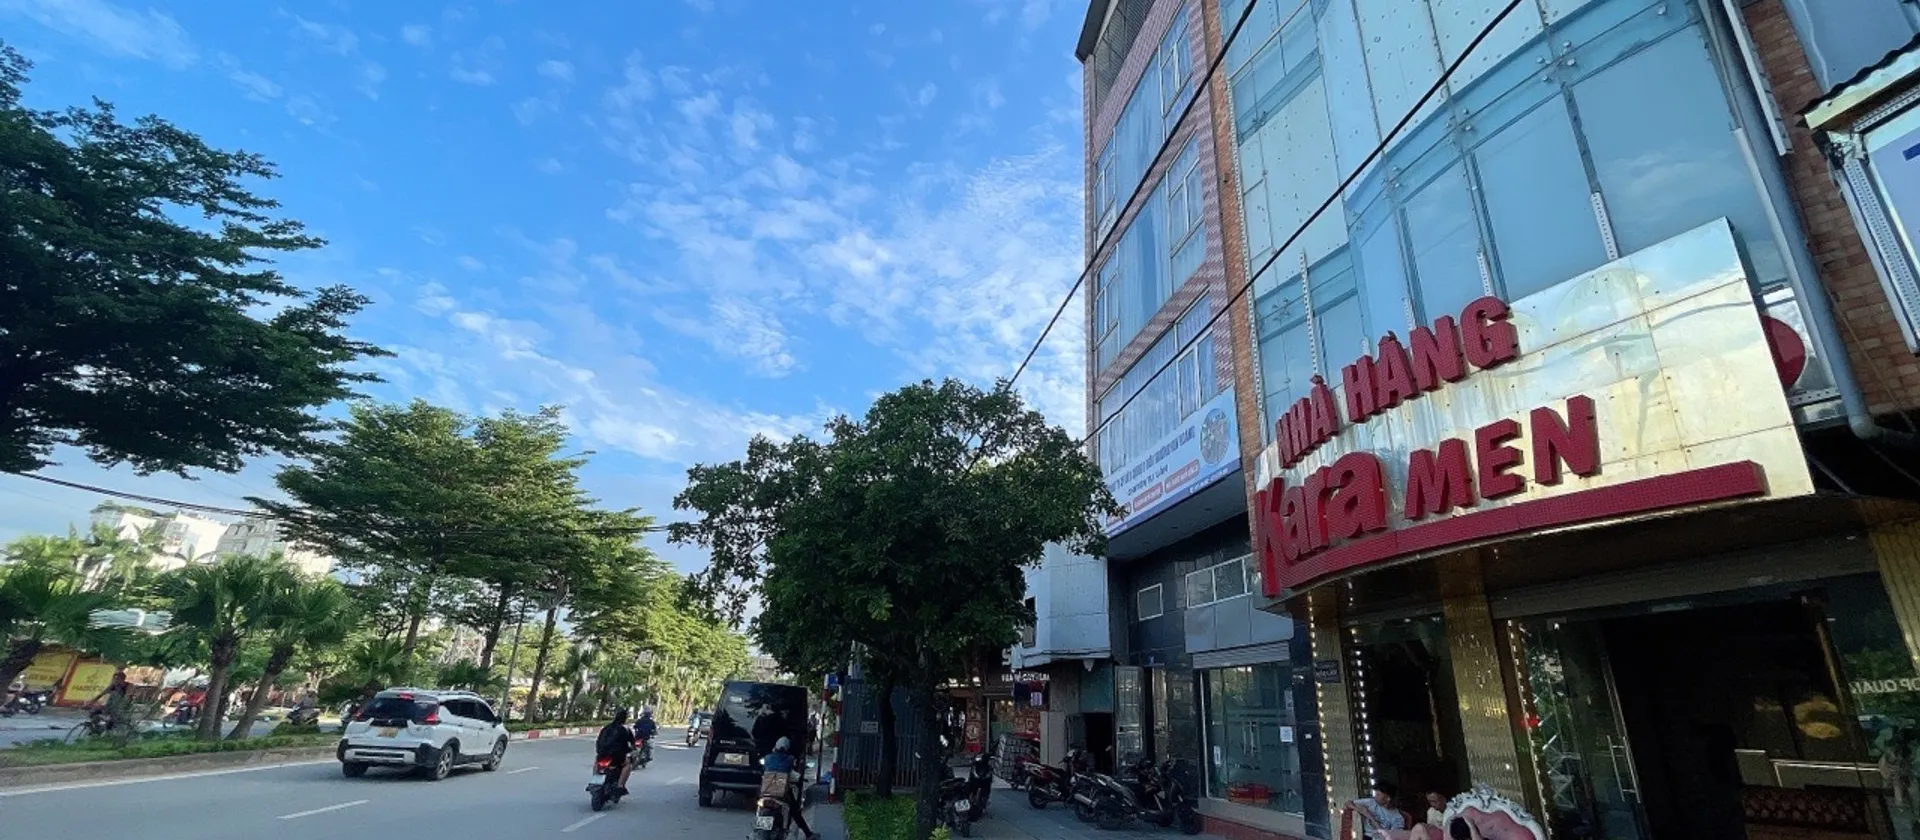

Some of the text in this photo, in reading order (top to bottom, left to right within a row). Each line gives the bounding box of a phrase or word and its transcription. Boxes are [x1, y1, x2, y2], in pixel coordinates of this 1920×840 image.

[1275, 375, 1340, 469] NHÀ
[1342, 296, 1520, 423] HÀNG
[1256, 451, 1388, 598] Kara
[1404, 394, 1602, 519] MEN
